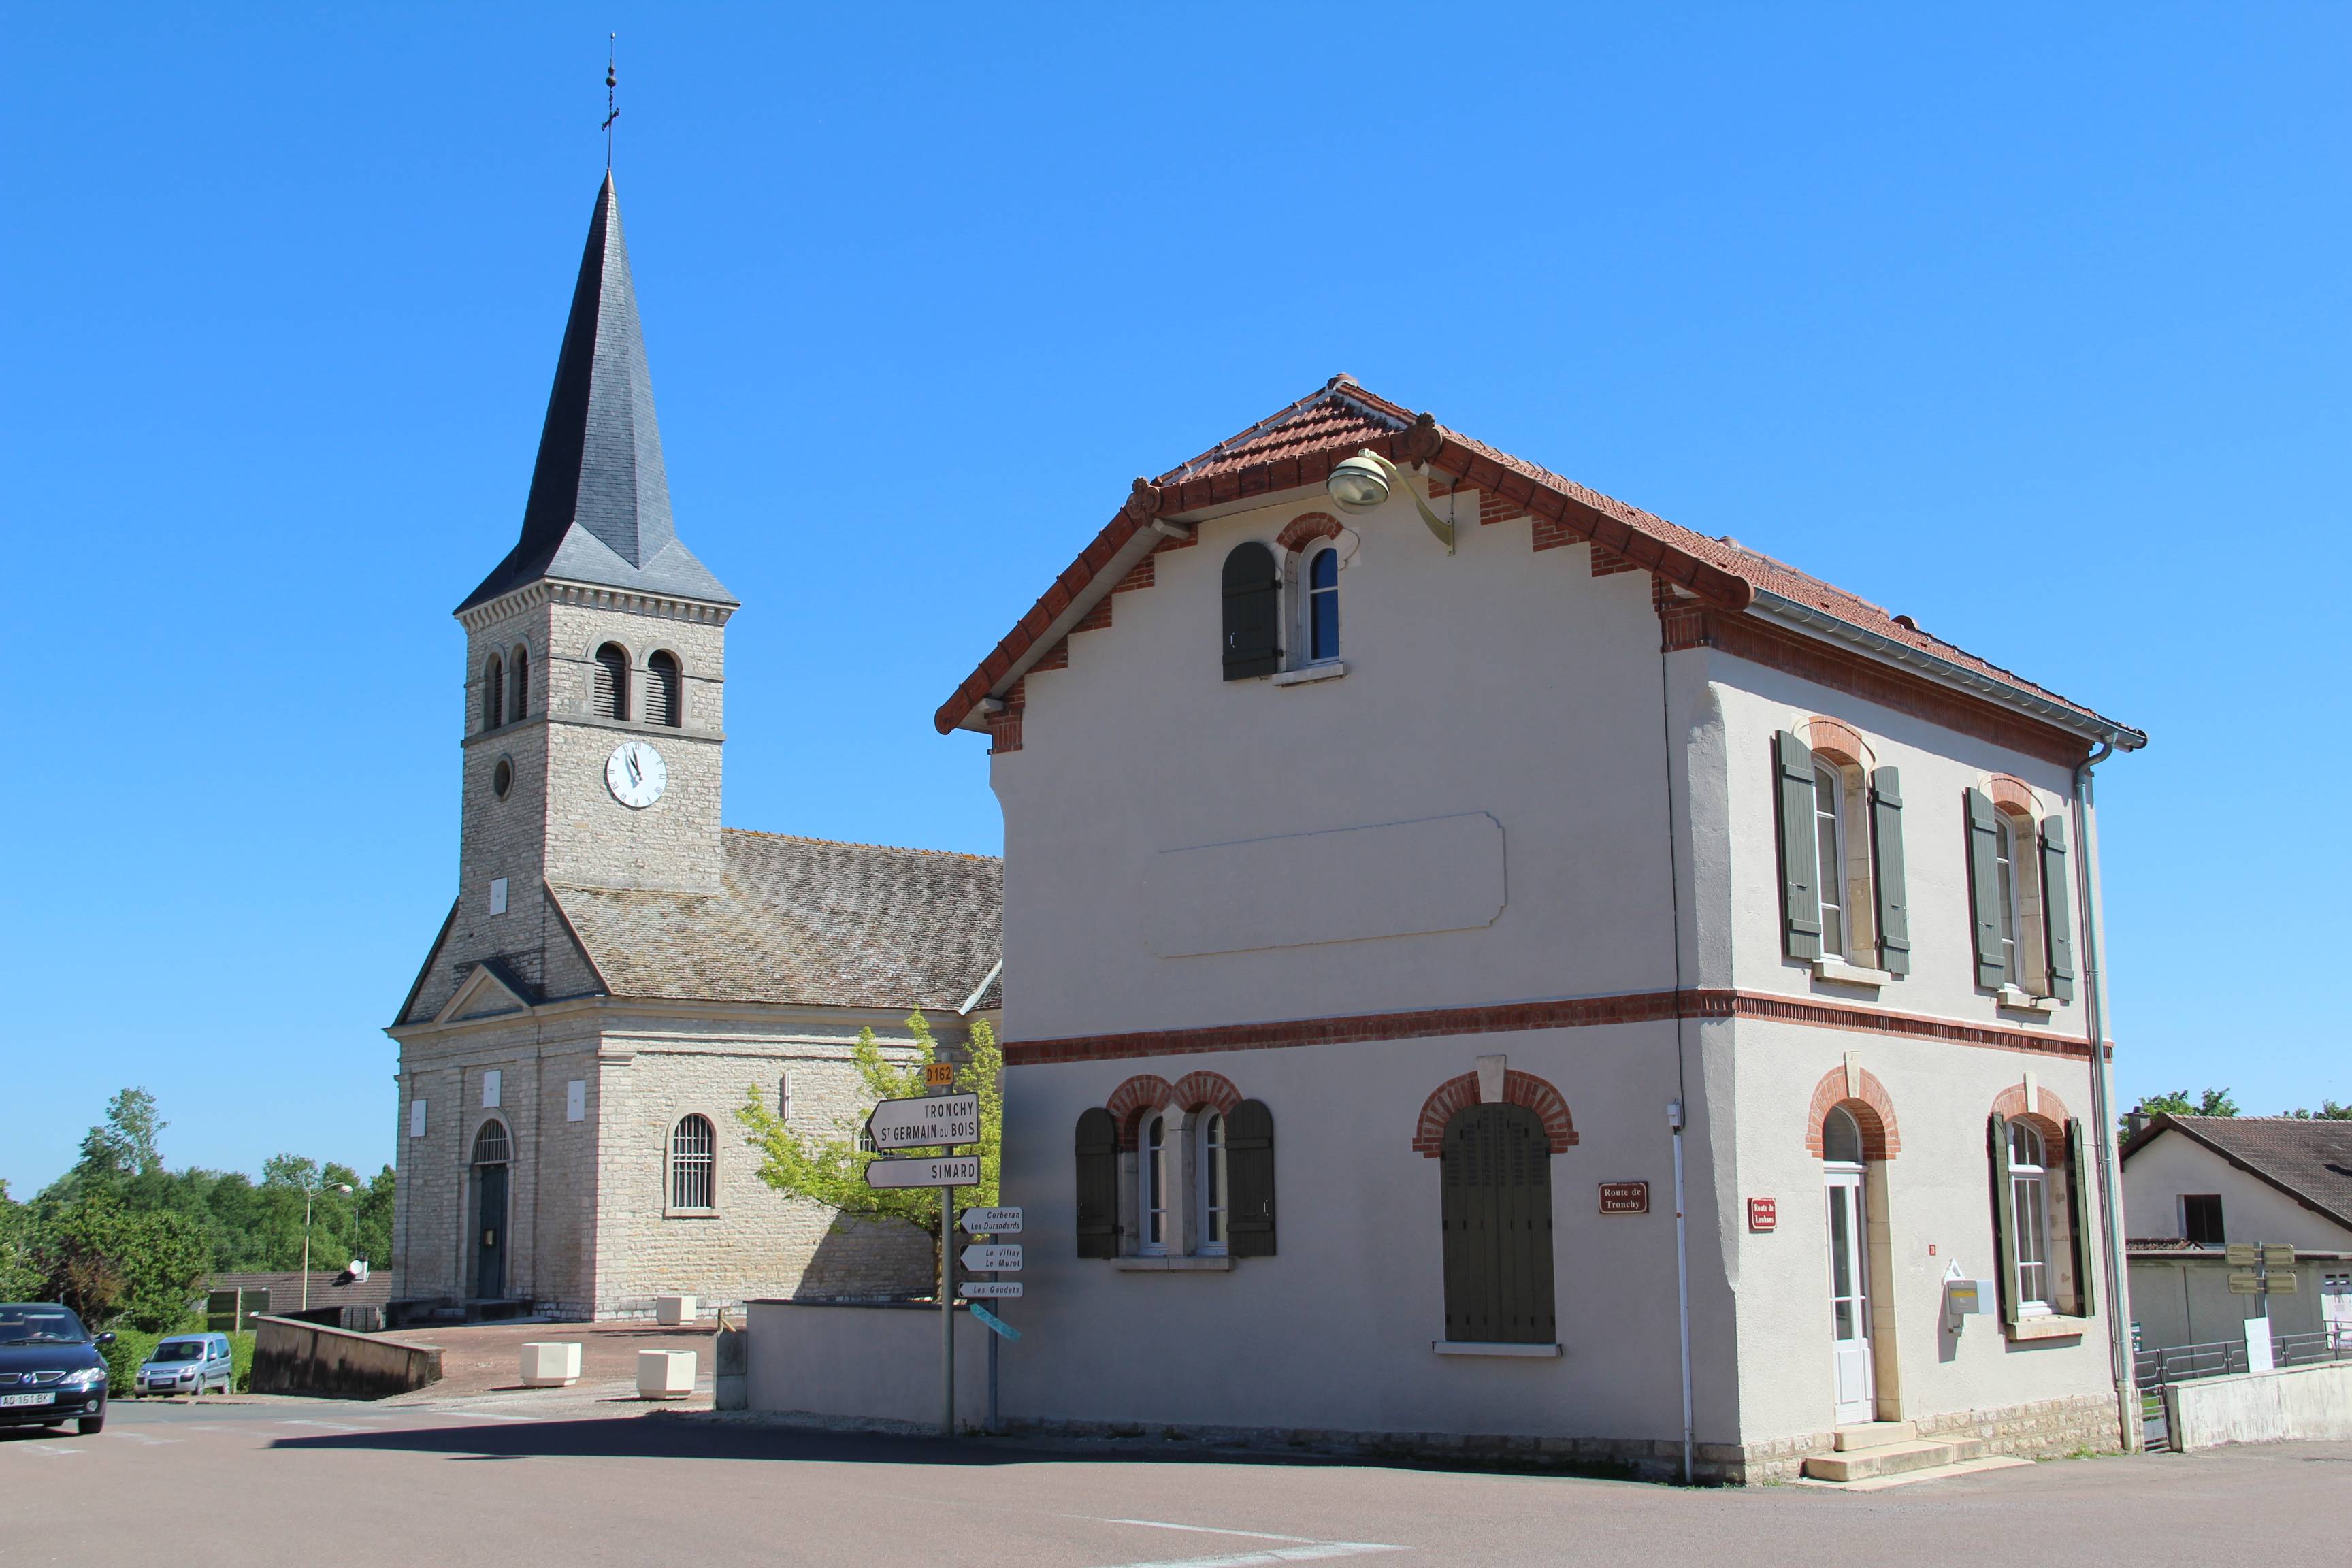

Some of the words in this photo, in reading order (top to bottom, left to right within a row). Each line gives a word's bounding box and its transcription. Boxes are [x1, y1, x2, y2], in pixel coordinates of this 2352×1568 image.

[927, 1068, 932, 1081] D
[935, 1067, 951, 1081] 162
[925, 1102, 973, 1118] TRONCHY
[894, 1124, 936, 1141] GERMAIN
[940, 1129, 948, 1137] DU
[951, 1122, 975, 1137] BOIS
[932, 1163, 975, 1179] SIMARD
[1604, 1189, 1628, 1197] Route
[1631, 1188, 1641, 1196] de
[1606, 1200, 1640, 1209] Tronchy
[984, 1222, 1019, 1230] Durandards
[999, 1248, 1019, 1258] Villey
[998, 1259, 1020, 1267] Murot
[974, 1285, 985, 1294] Les
[990, 1286, 1019, 1294] Gaudets
